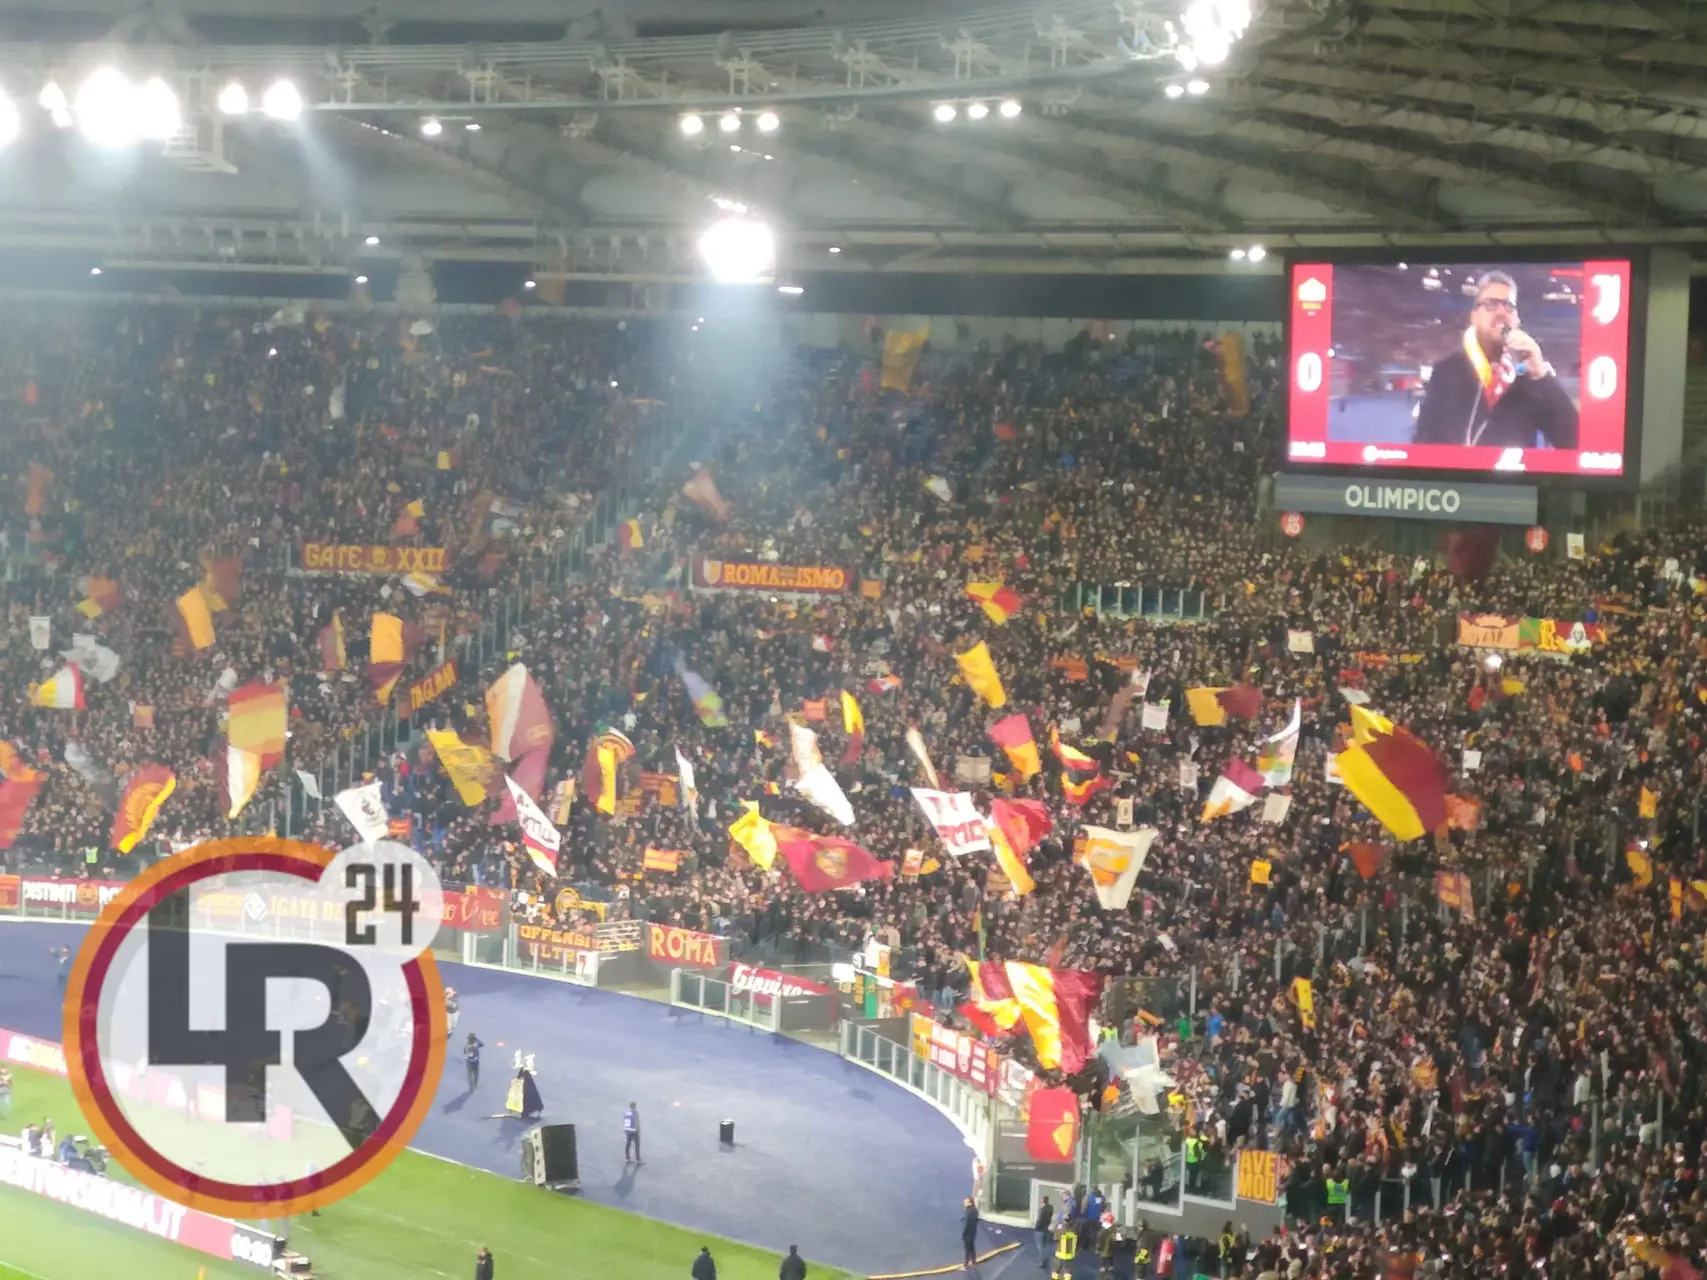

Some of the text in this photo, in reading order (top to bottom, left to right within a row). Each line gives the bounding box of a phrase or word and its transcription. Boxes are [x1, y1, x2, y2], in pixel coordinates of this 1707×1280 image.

[1297, 352, 1323, 392] 0
[1588, 356, 1617, 398] 0
[1345, 485, 1460, 513] OLIMPICO
[305, 543, 446, 571] GATE XXII
[651, 927, 716, 966] ROMA
[1240, 1150, 1278, 1177] AVE
[1238, 1172, 1276, 1203] MOU
